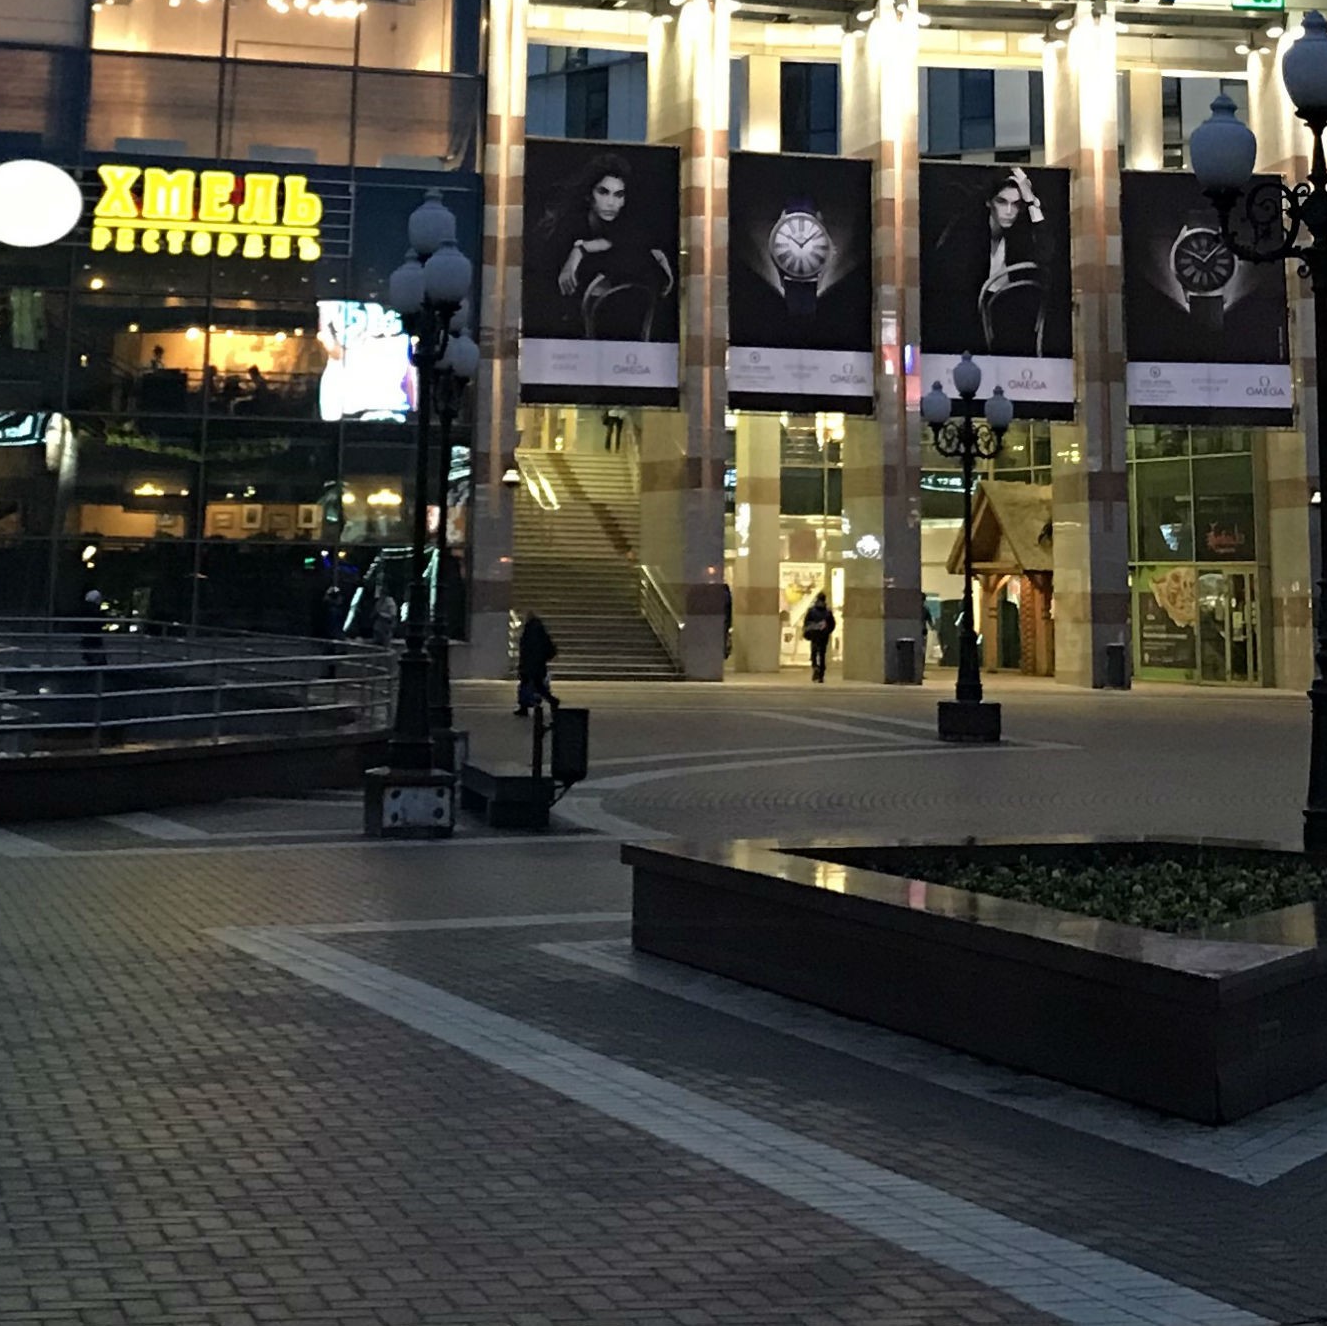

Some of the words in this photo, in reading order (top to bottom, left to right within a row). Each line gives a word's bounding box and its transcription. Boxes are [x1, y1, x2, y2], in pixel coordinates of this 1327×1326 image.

[94, 165, 323, 226] ХМЕЛЬ
[612, 364, 651, 375] OMEGA
[1008, 379, 1047, 390] OMEGA
[1245, 387, 1286, 397] OMEGA
